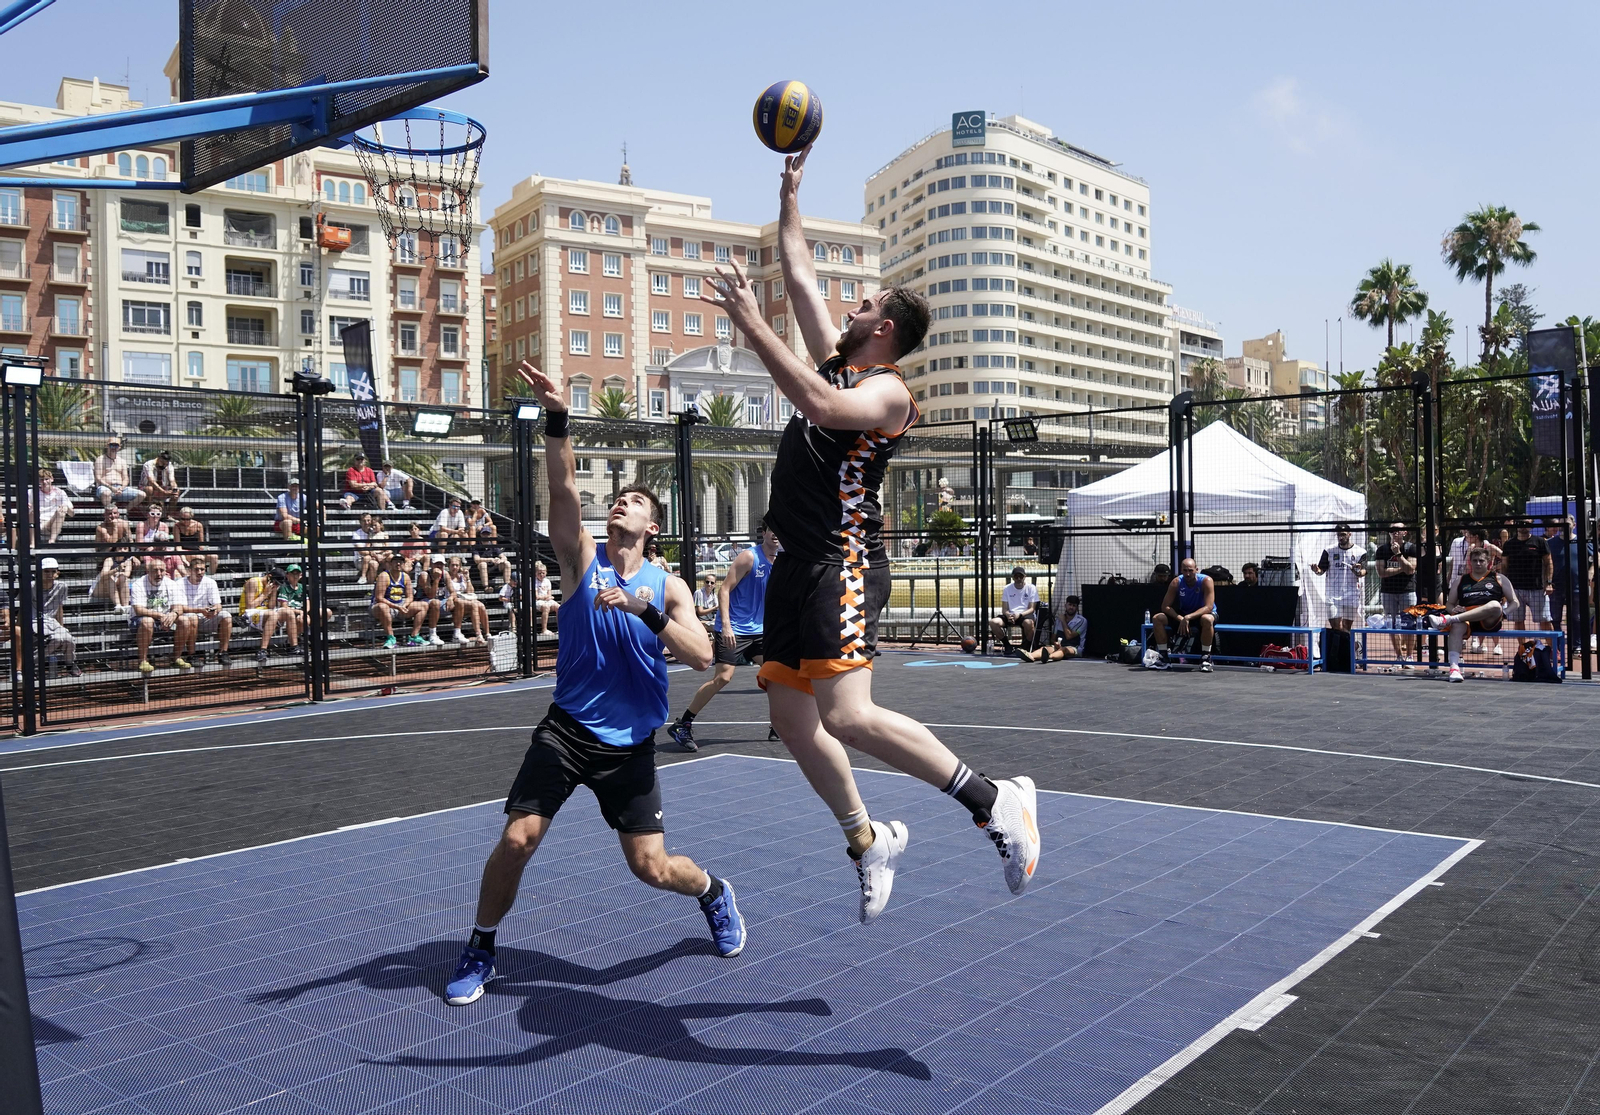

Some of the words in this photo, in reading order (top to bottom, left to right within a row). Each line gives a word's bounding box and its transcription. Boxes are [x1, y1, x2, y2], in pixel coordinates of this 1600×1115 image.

[956, 114, 982, 129] AC
[133, 397, 170, 409] Unicaja
[172, 399, 202, 409] Banco
[322, 405, 348, 415] nicaja
